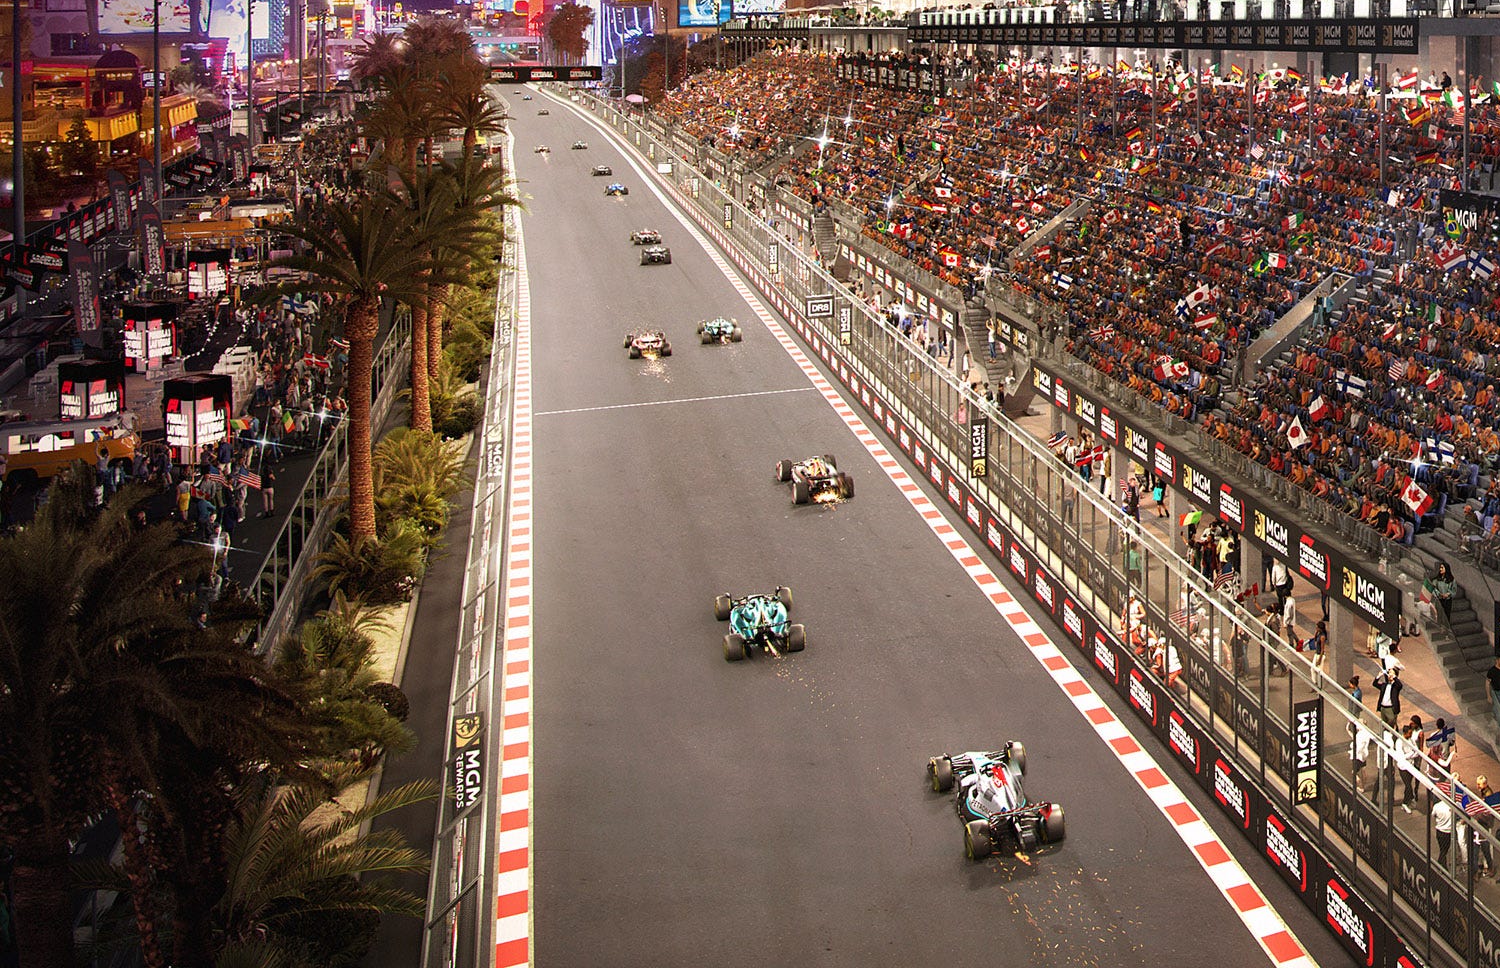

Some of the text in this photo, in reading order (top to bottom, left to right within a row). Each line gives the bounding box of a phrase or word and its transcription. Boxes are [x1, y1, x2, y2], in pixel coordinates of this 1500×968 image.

[1324, 25, 1341, 38] MGM
[1357, 25, 1376, 38] MGM
[1393, 24, 1414, 38] MGM
[1455, 208, 1477, 230] MGM
[89, 392, 111, 405] FORMULA
[89, 401, 118, 415] LAS VEGAS
[1082, 398, 1096, 418] MGM
[972, 424, 981, 458] MGM
[1132, 431, 1148, 453] MGM
[1193, 469, 1211, 495] MGM
[1266, 516, 1288, 546] MGM
[1357, 575, 1385, 609] MGM
[1297, 711, 1310, 769] MGM
[465, 749, 481, 807] MGM
[1327, 884, 1358, 922] FORMULA
[1327, 895, 1364, 939] LAS VEGAS
[1327, 904, 1367, 954] GRAND PRIX
